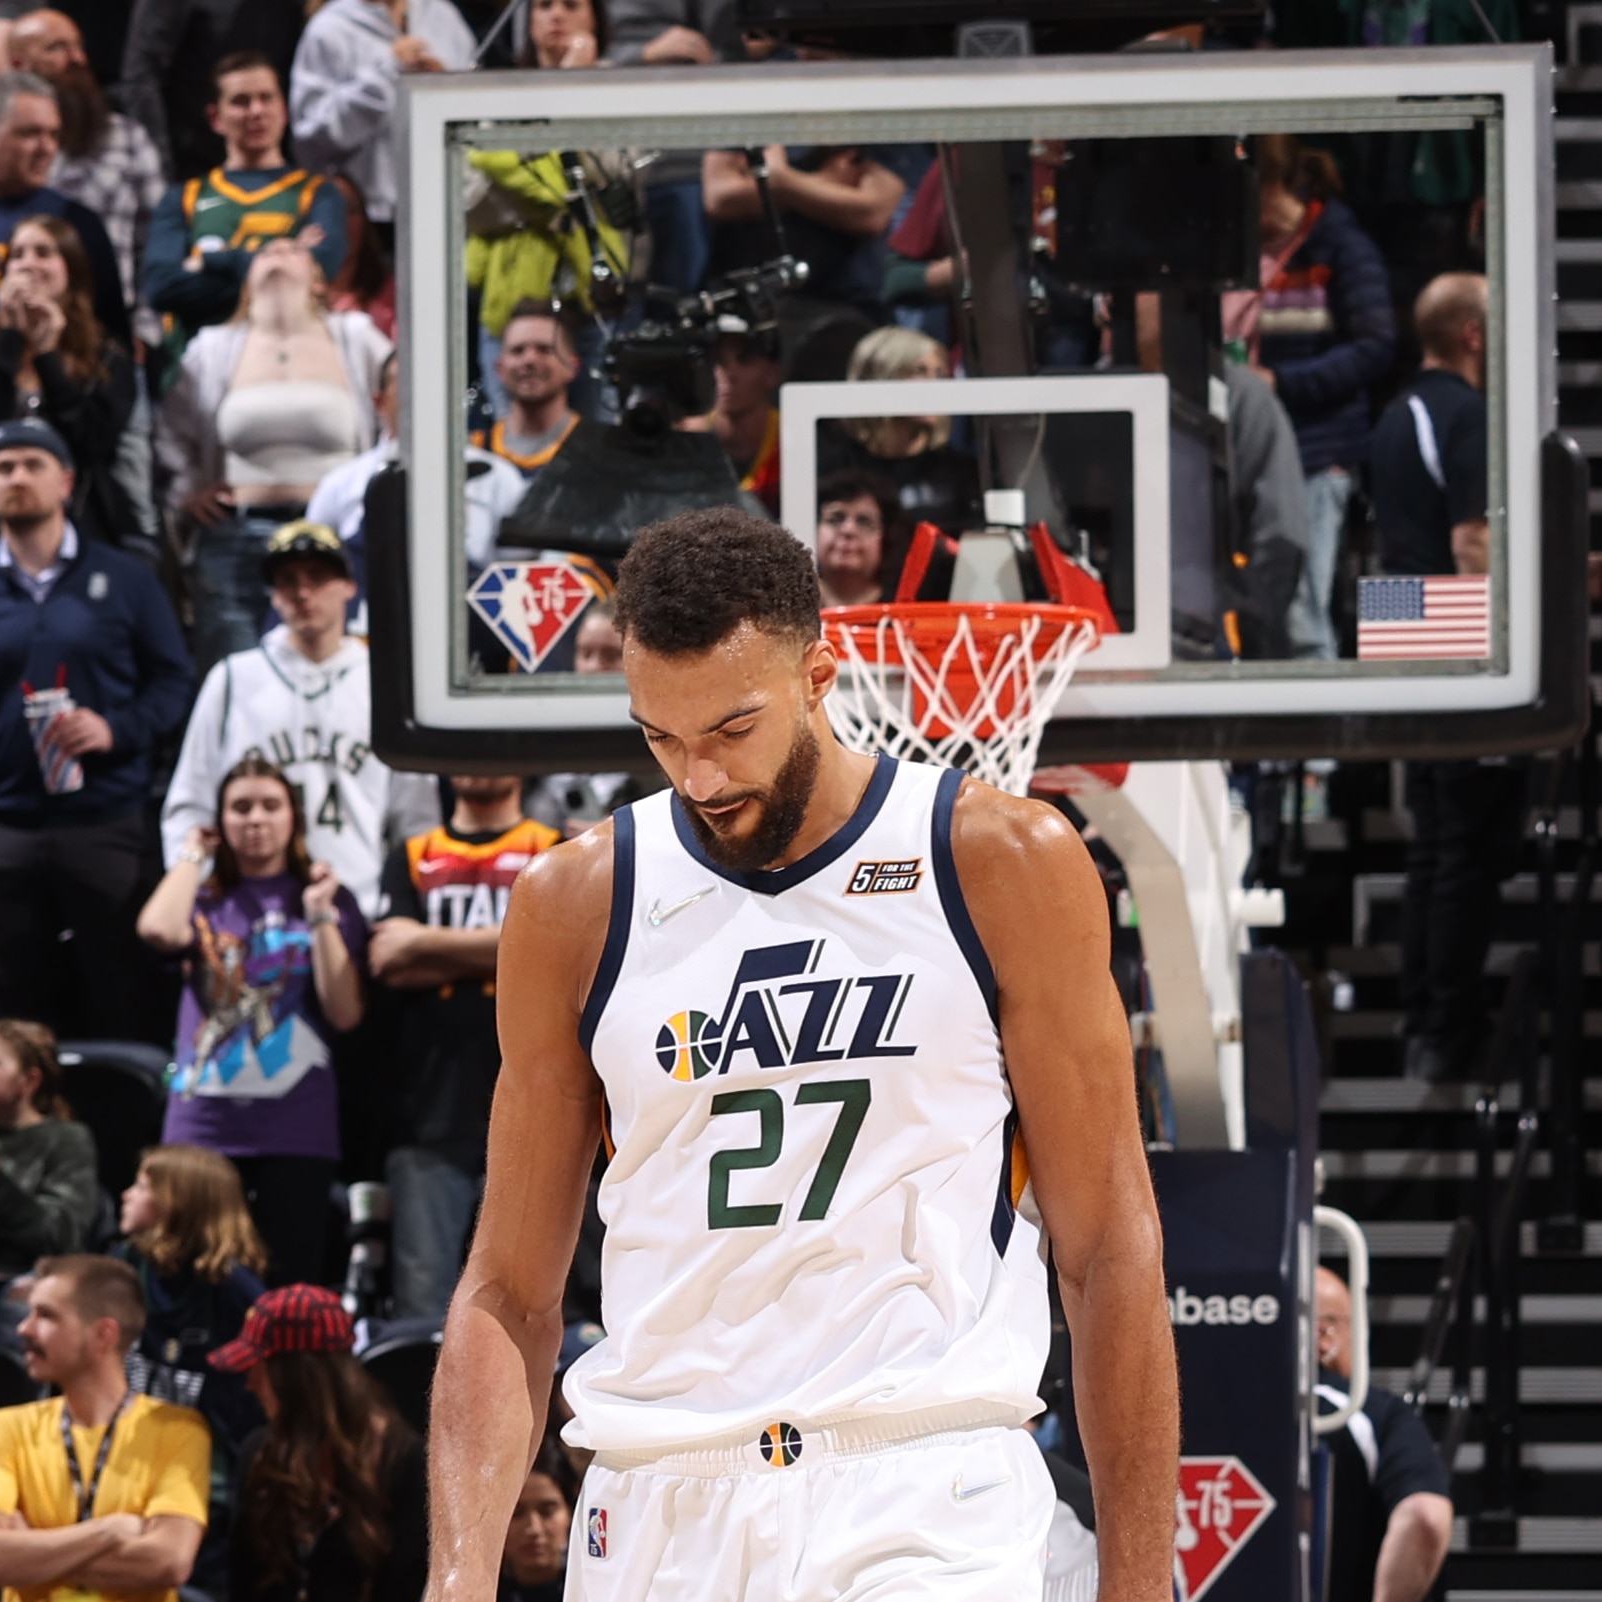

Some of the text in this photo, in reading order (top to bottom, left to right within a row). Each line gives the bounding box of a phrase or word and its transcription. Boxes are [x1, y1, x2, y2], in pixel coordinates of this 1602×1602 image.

[852, 865, 876, 892] 5
[873, 875, 918, 890] FIGHT
[656, 938, 918, 1083] JAZZ
[707, 1077, 872, 1230] 27
[1170, 1286, 1280, 1325] base
[1195, 1480, 1234, 1528] 75
